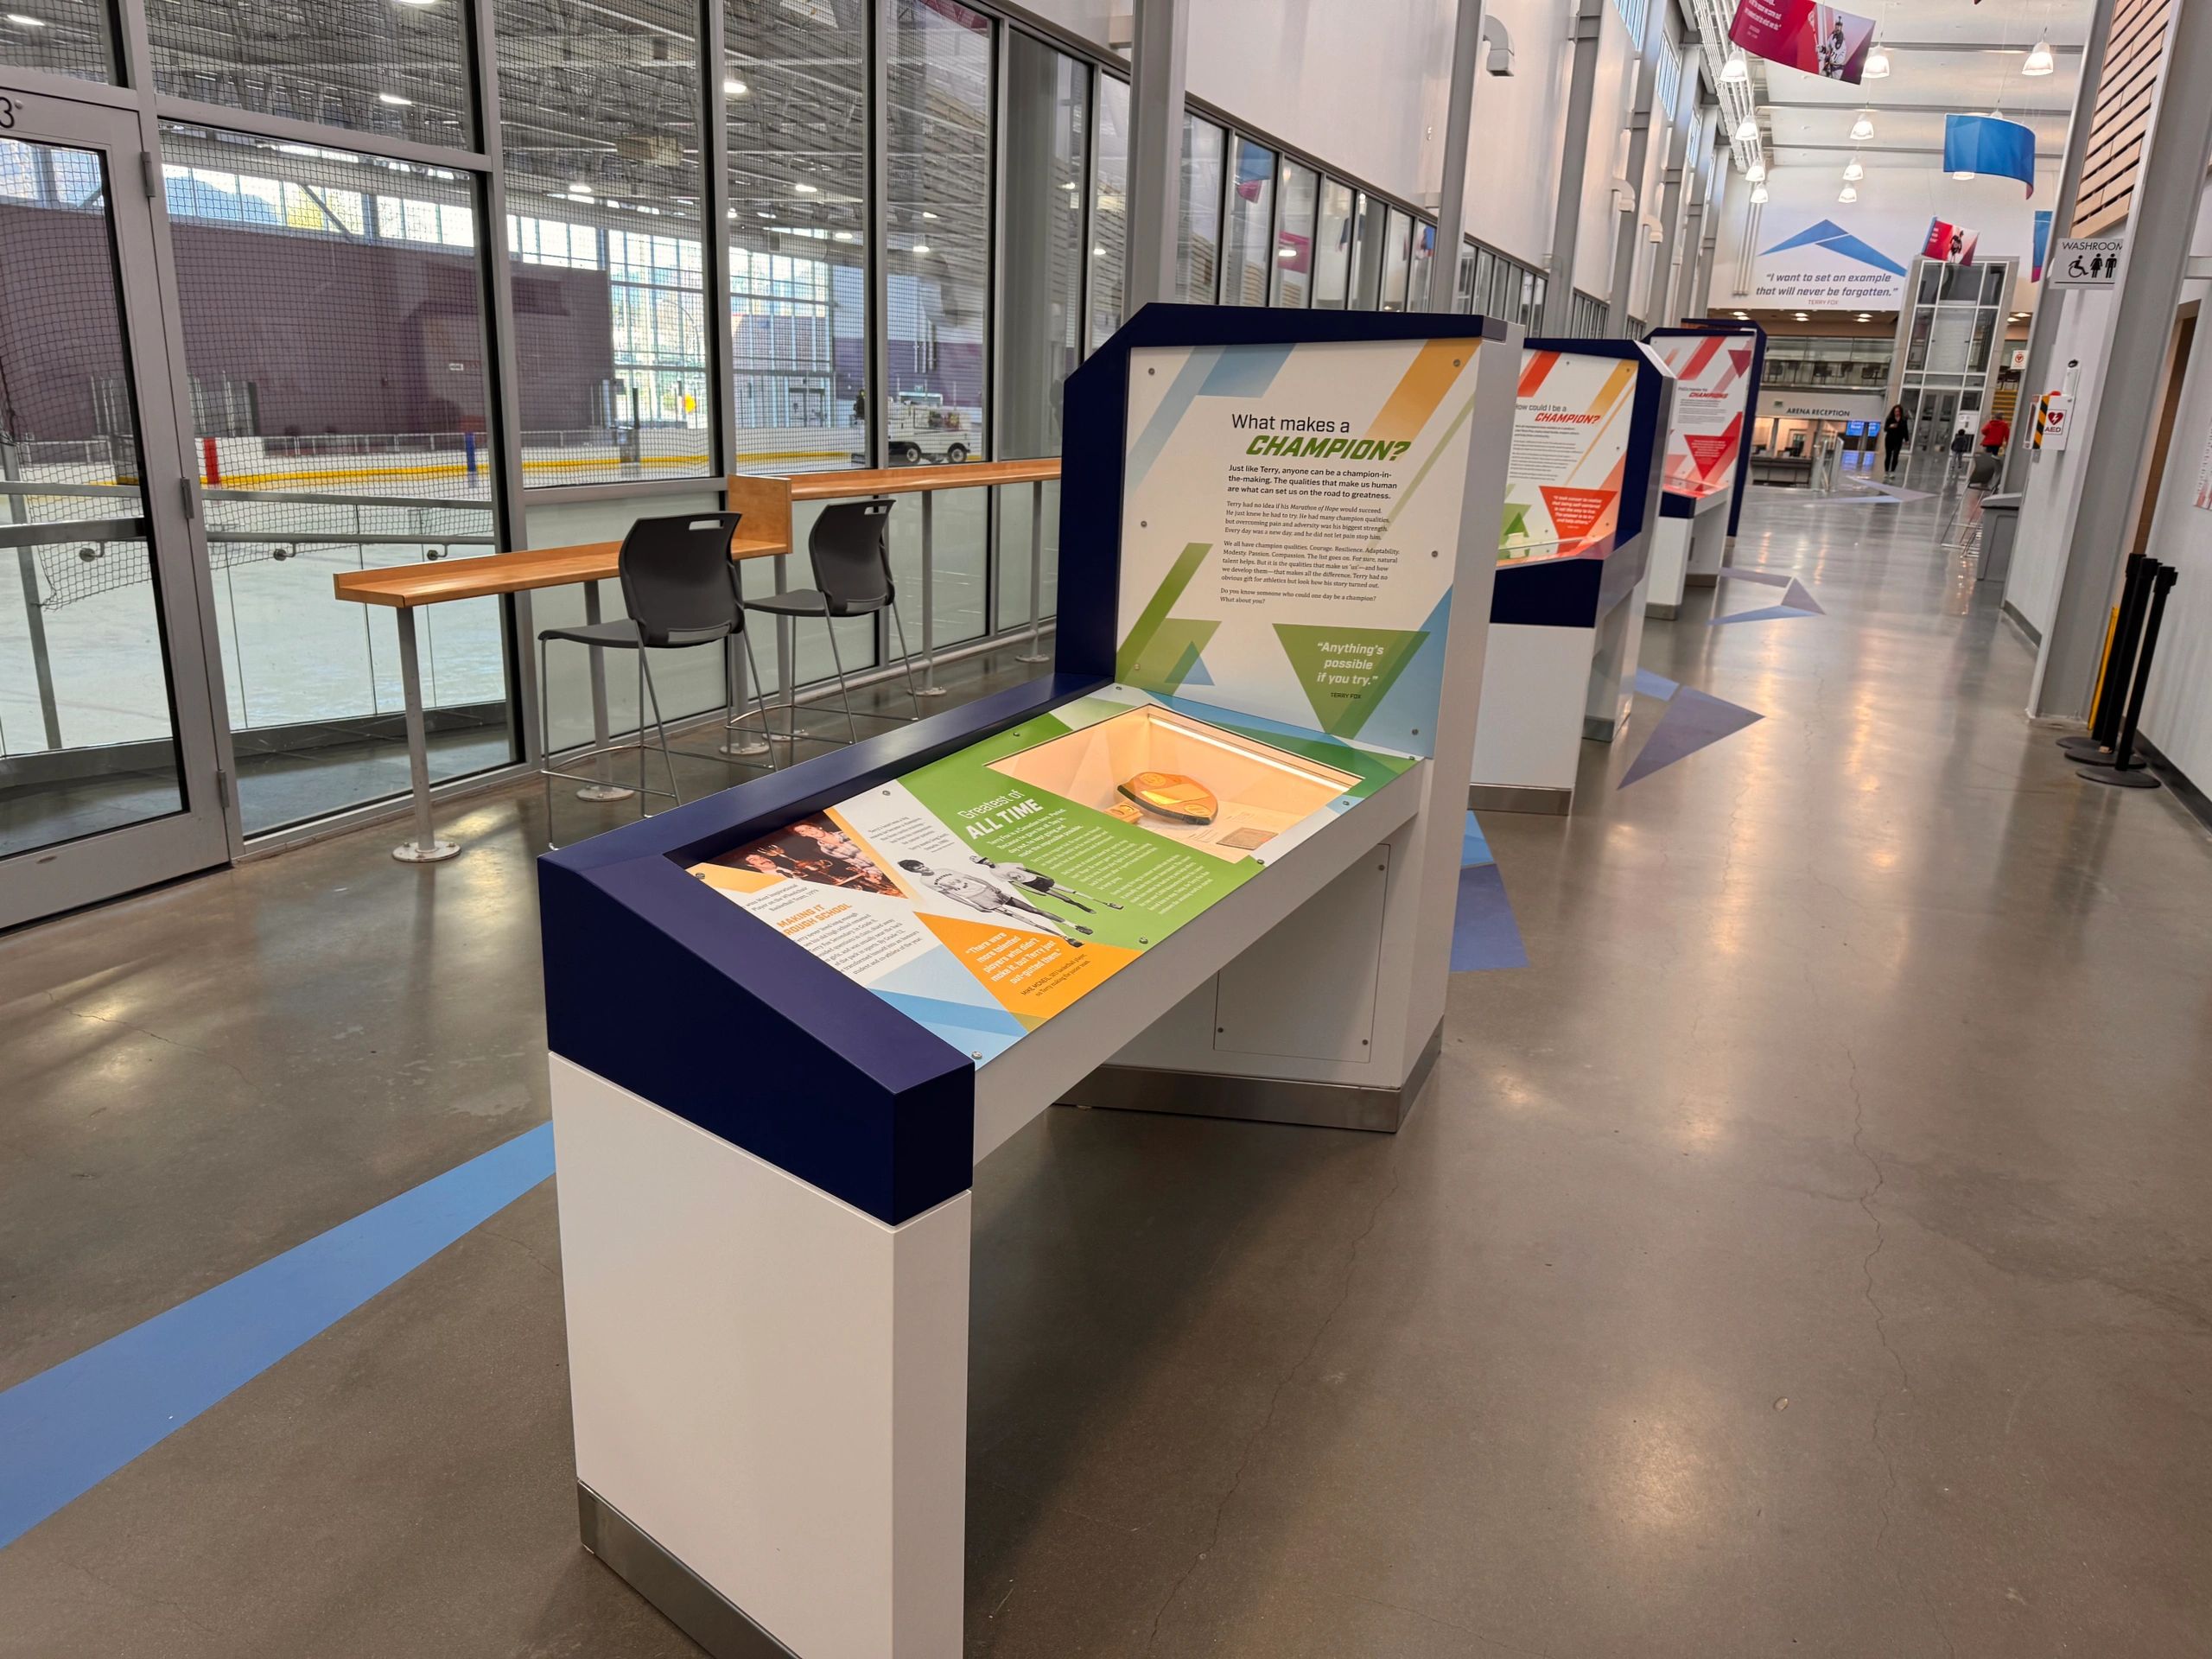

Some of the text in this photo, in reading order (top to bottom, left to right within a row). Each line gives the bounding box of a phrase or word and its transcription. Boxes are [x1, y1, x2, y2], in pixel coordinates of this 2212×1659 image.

[0, 96, 15, 129] 3
[1766, 273, 1774, 281] “I
[1847, 273, 1892, 283] example
[1755, 286, 1776, 295] that
[1778, 286, 1795, 295] will
[1826, 287, 1840, 295] be
[1841, 287, 1898, 297] forgotten.”
[1231, 413, 1349, 433] What makes a
[1534, 412, 1601, 424] CHAMPION?
[1246, 435, 1411, 461] CHAMPION?
[1260, 465, 1280, 475] Terry,
[1342, 469, 1391, 478] champion-in-
[1228, 474, 1272, 484] the-making.
[1317, 642, 1384, 656] “Anything’s
[1323, 659, 1373, 669] possible
[1316, 672, 1378, 686] if you try.”
[957, 789, 1025, 819] Greatest of
[965, 798, 1044, 839] ALL TIME
[776, 908, 816, 928] MAKING
[782, 917, 818, 937] ROUGH
